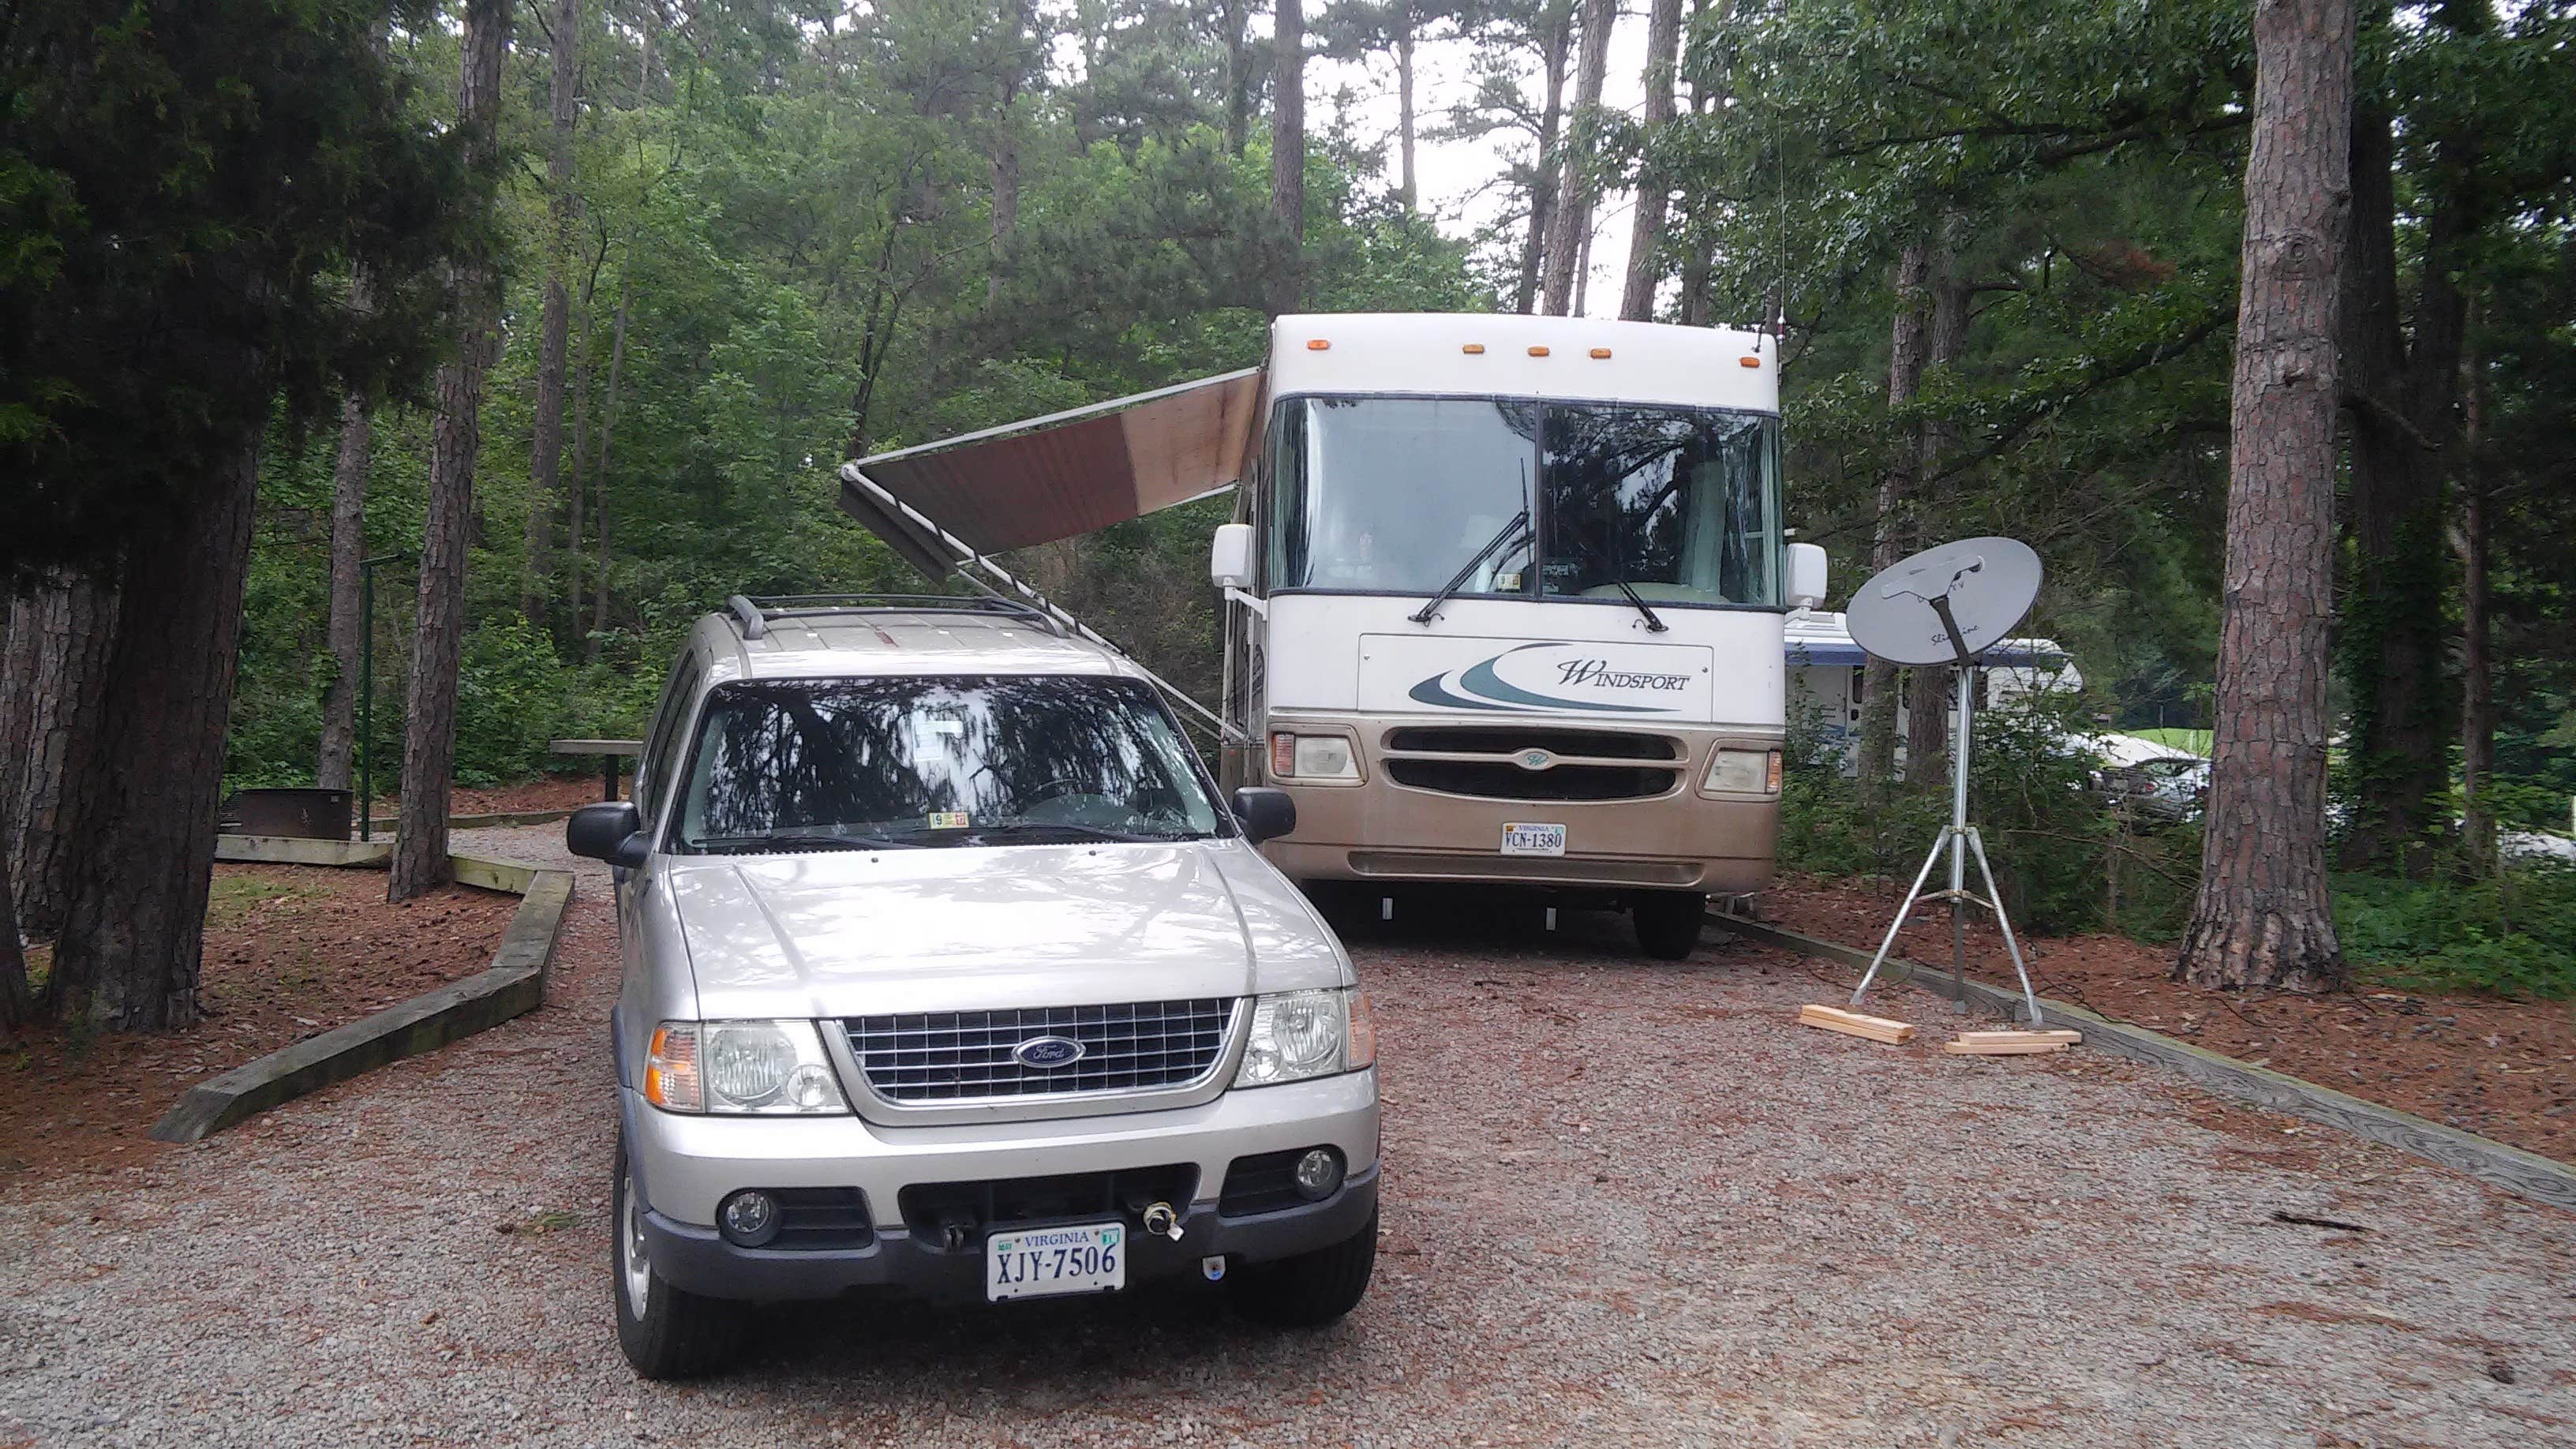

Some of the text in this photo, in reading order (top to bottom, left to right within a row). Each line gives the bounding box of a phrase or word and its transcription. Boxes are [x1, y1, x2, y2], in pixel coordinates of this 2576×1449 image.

[1930, 625, 1979, 646] Sliine
[1505, 832, 1562, 848] VCN-1380
[1033, 1043, 1065, 1060] Ford
[1025, 1231, 1089, 1247] VIRGINIA
[997, 1242, 1117, 1284] XJY-7506
